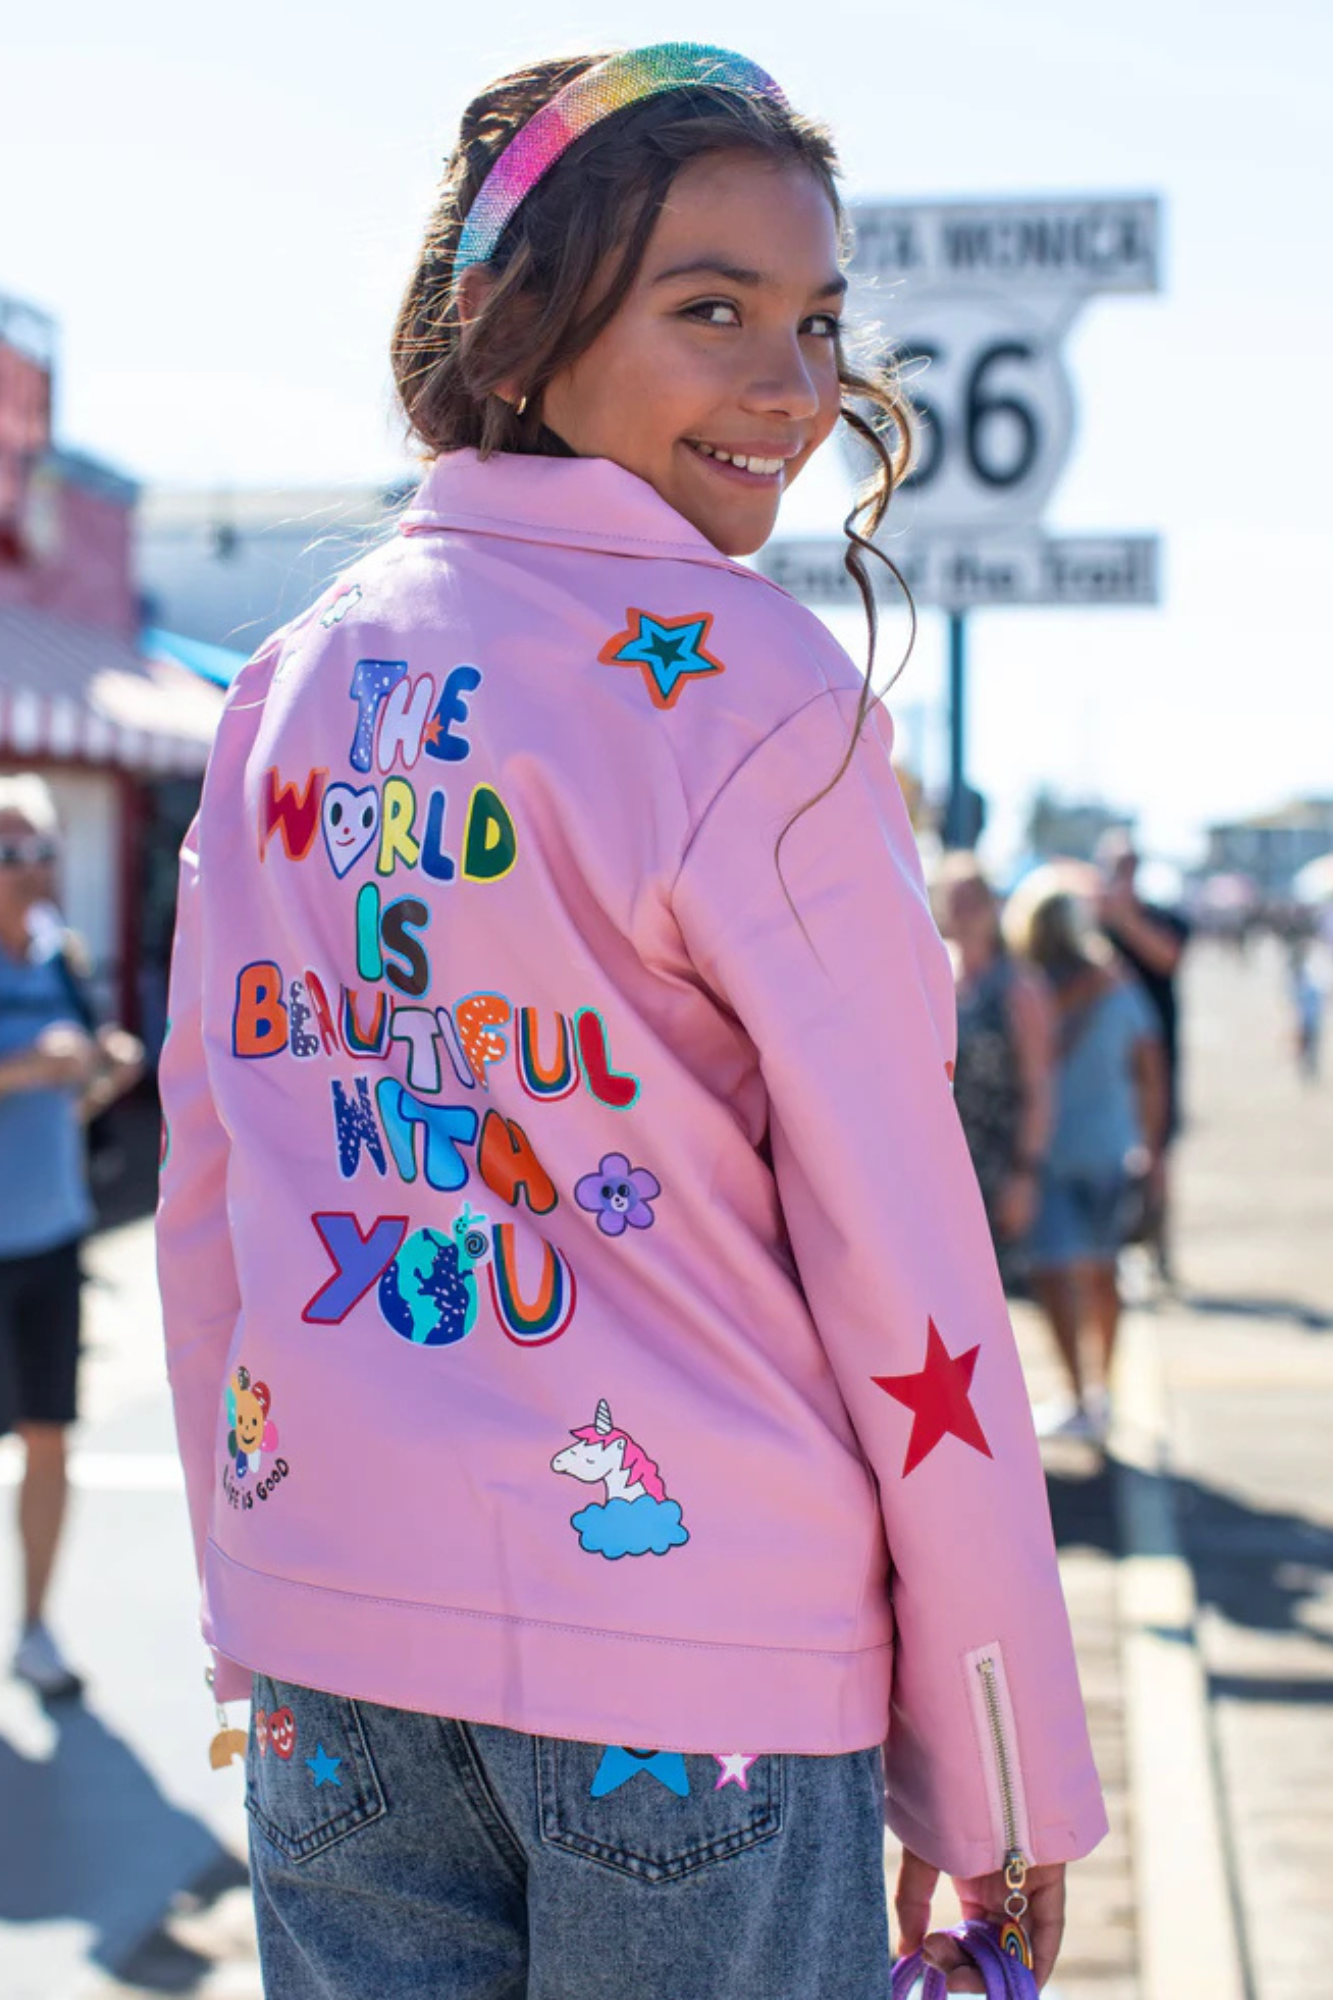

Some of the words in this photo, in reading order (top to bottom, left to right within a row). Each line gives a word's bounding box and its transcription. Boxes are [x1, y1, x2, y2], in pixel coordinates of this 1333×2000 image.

[349, 658, 482, 775] THE
[259, 766, 518, 885] WORLD
[356, 881, 432, 1002] IS
[232, 959, 641, 1111] BEAUTIFUL
[330, 1074, 559, 1215] WITH
[301, 1209, 577, 1347] YOU
